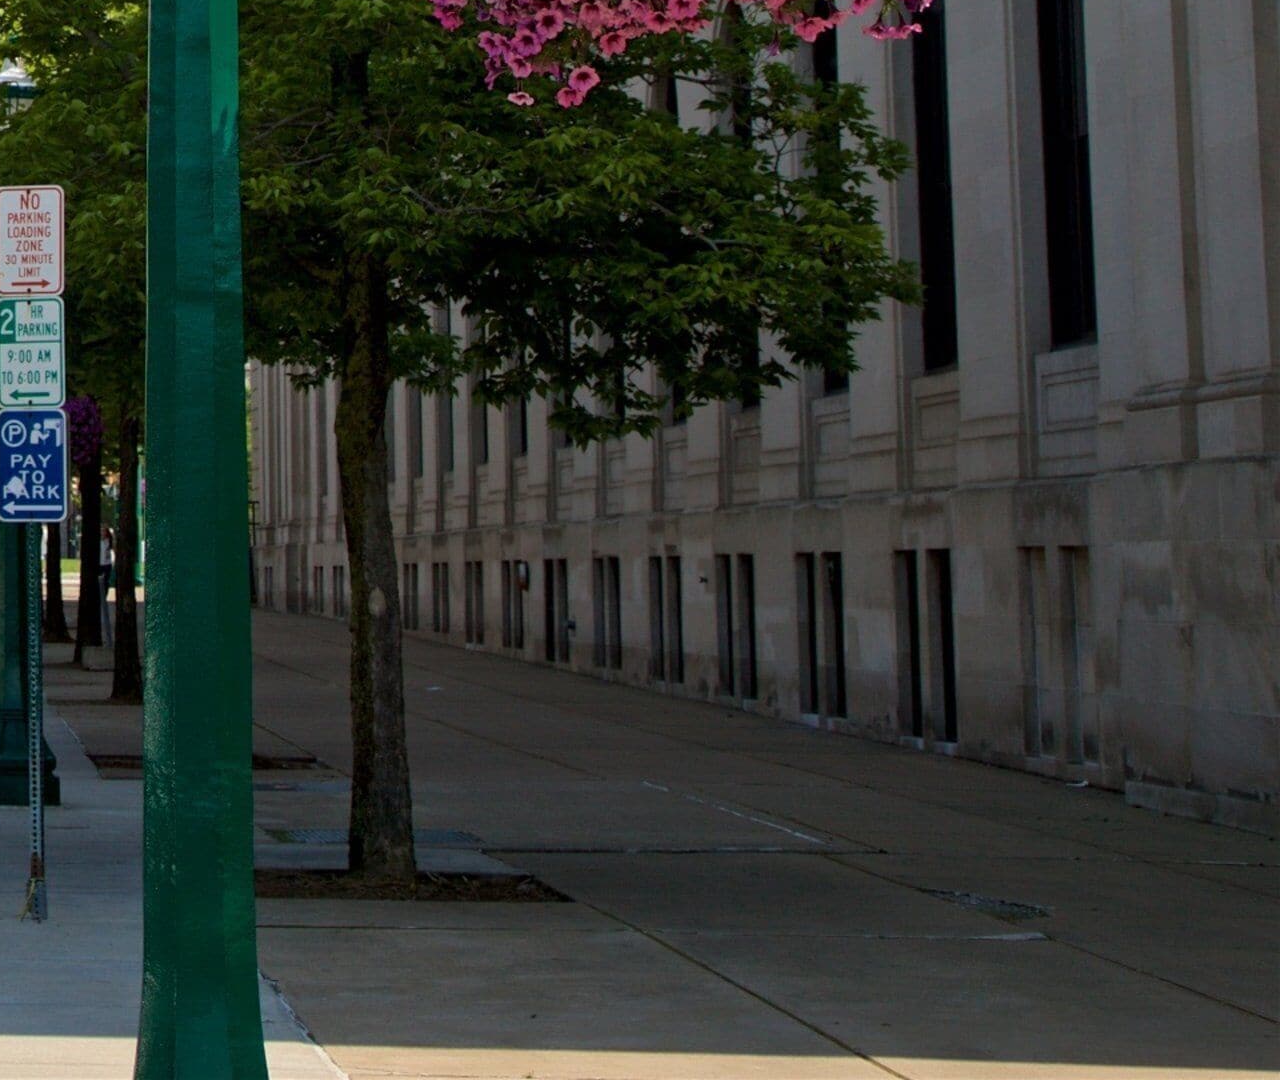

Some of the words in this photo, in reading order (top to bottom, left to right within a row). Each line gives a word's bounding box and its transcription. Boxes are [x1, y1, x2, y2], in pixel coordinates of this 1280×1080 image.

[20, 193, 40, 210] NO
[7, 212, 52, 224] PARKING
[7, 226, 52, 238] LOADING
[16, 240, 44, 252] ZONE
[4, 254, 17, 265] 30
[21, 254, 54, 265] MINUTE
[18, 267, 41, 278] LIMIT
[0, 308, 14, 335] 2
[30, 305, 44, 319] HR
[17, 322, 58, 336] PARKING
[7, 349, 32, 363] 9:00
[37, 349, 51, 362] AM
[1, 371, 13, 385] TO
[17, 370, 40, 384] 6:00
[45, 370, 58, 384] PM
[8, 424, 22, 442] P
[10, 454, 52, 468] PAY
[18, 470, 45, 484] TO
